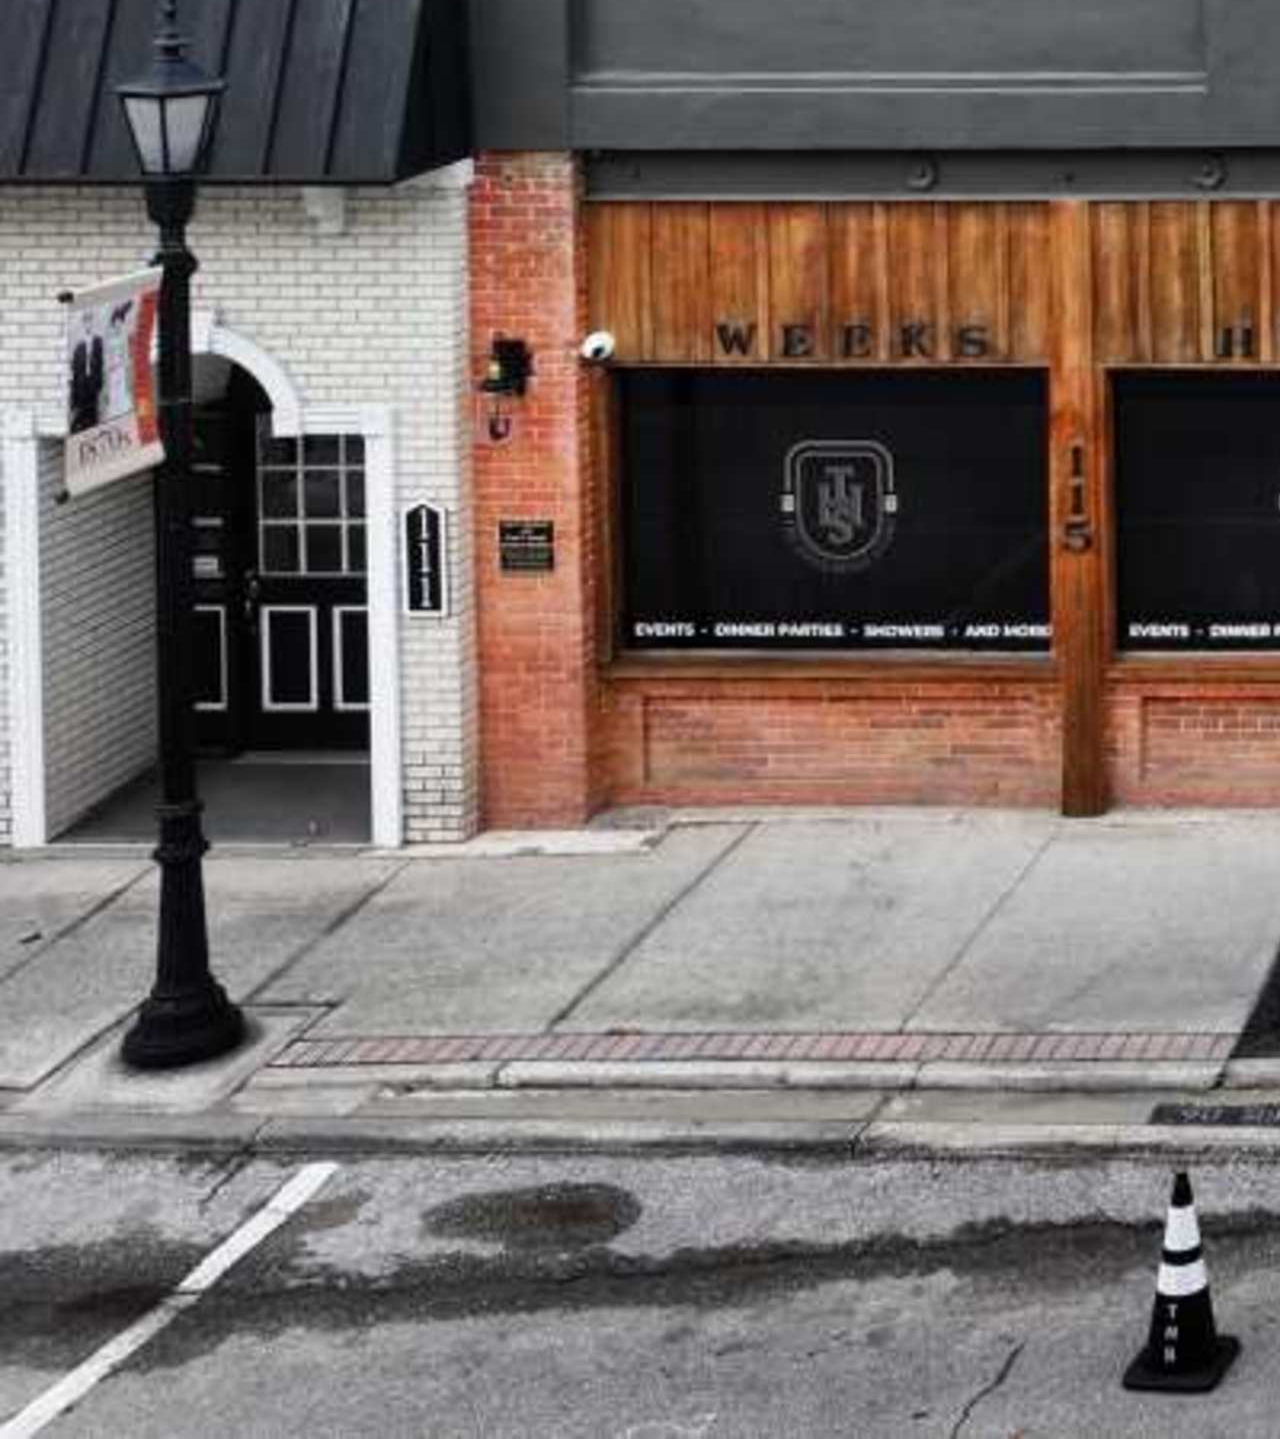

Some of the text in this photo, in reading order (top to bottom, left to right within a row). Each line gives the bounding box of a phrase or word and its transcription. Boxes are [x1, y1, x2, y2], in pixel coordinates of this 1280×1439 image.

[715, 322, 989, 358] WEEKS
[1064, 445, 1092, 554] 115
[635, 622, 696, 637] EVENTS
[714, 622, 775, 637] DINNER
[778, 622, 844, 637] PARTIES
[864, 623, 945, 638] SHOWERS
[964, 623, 1001, 638] AND
[1129, 622, 1189, 638] EVENTS
[1208, 622, 1271, 638] DINNER
